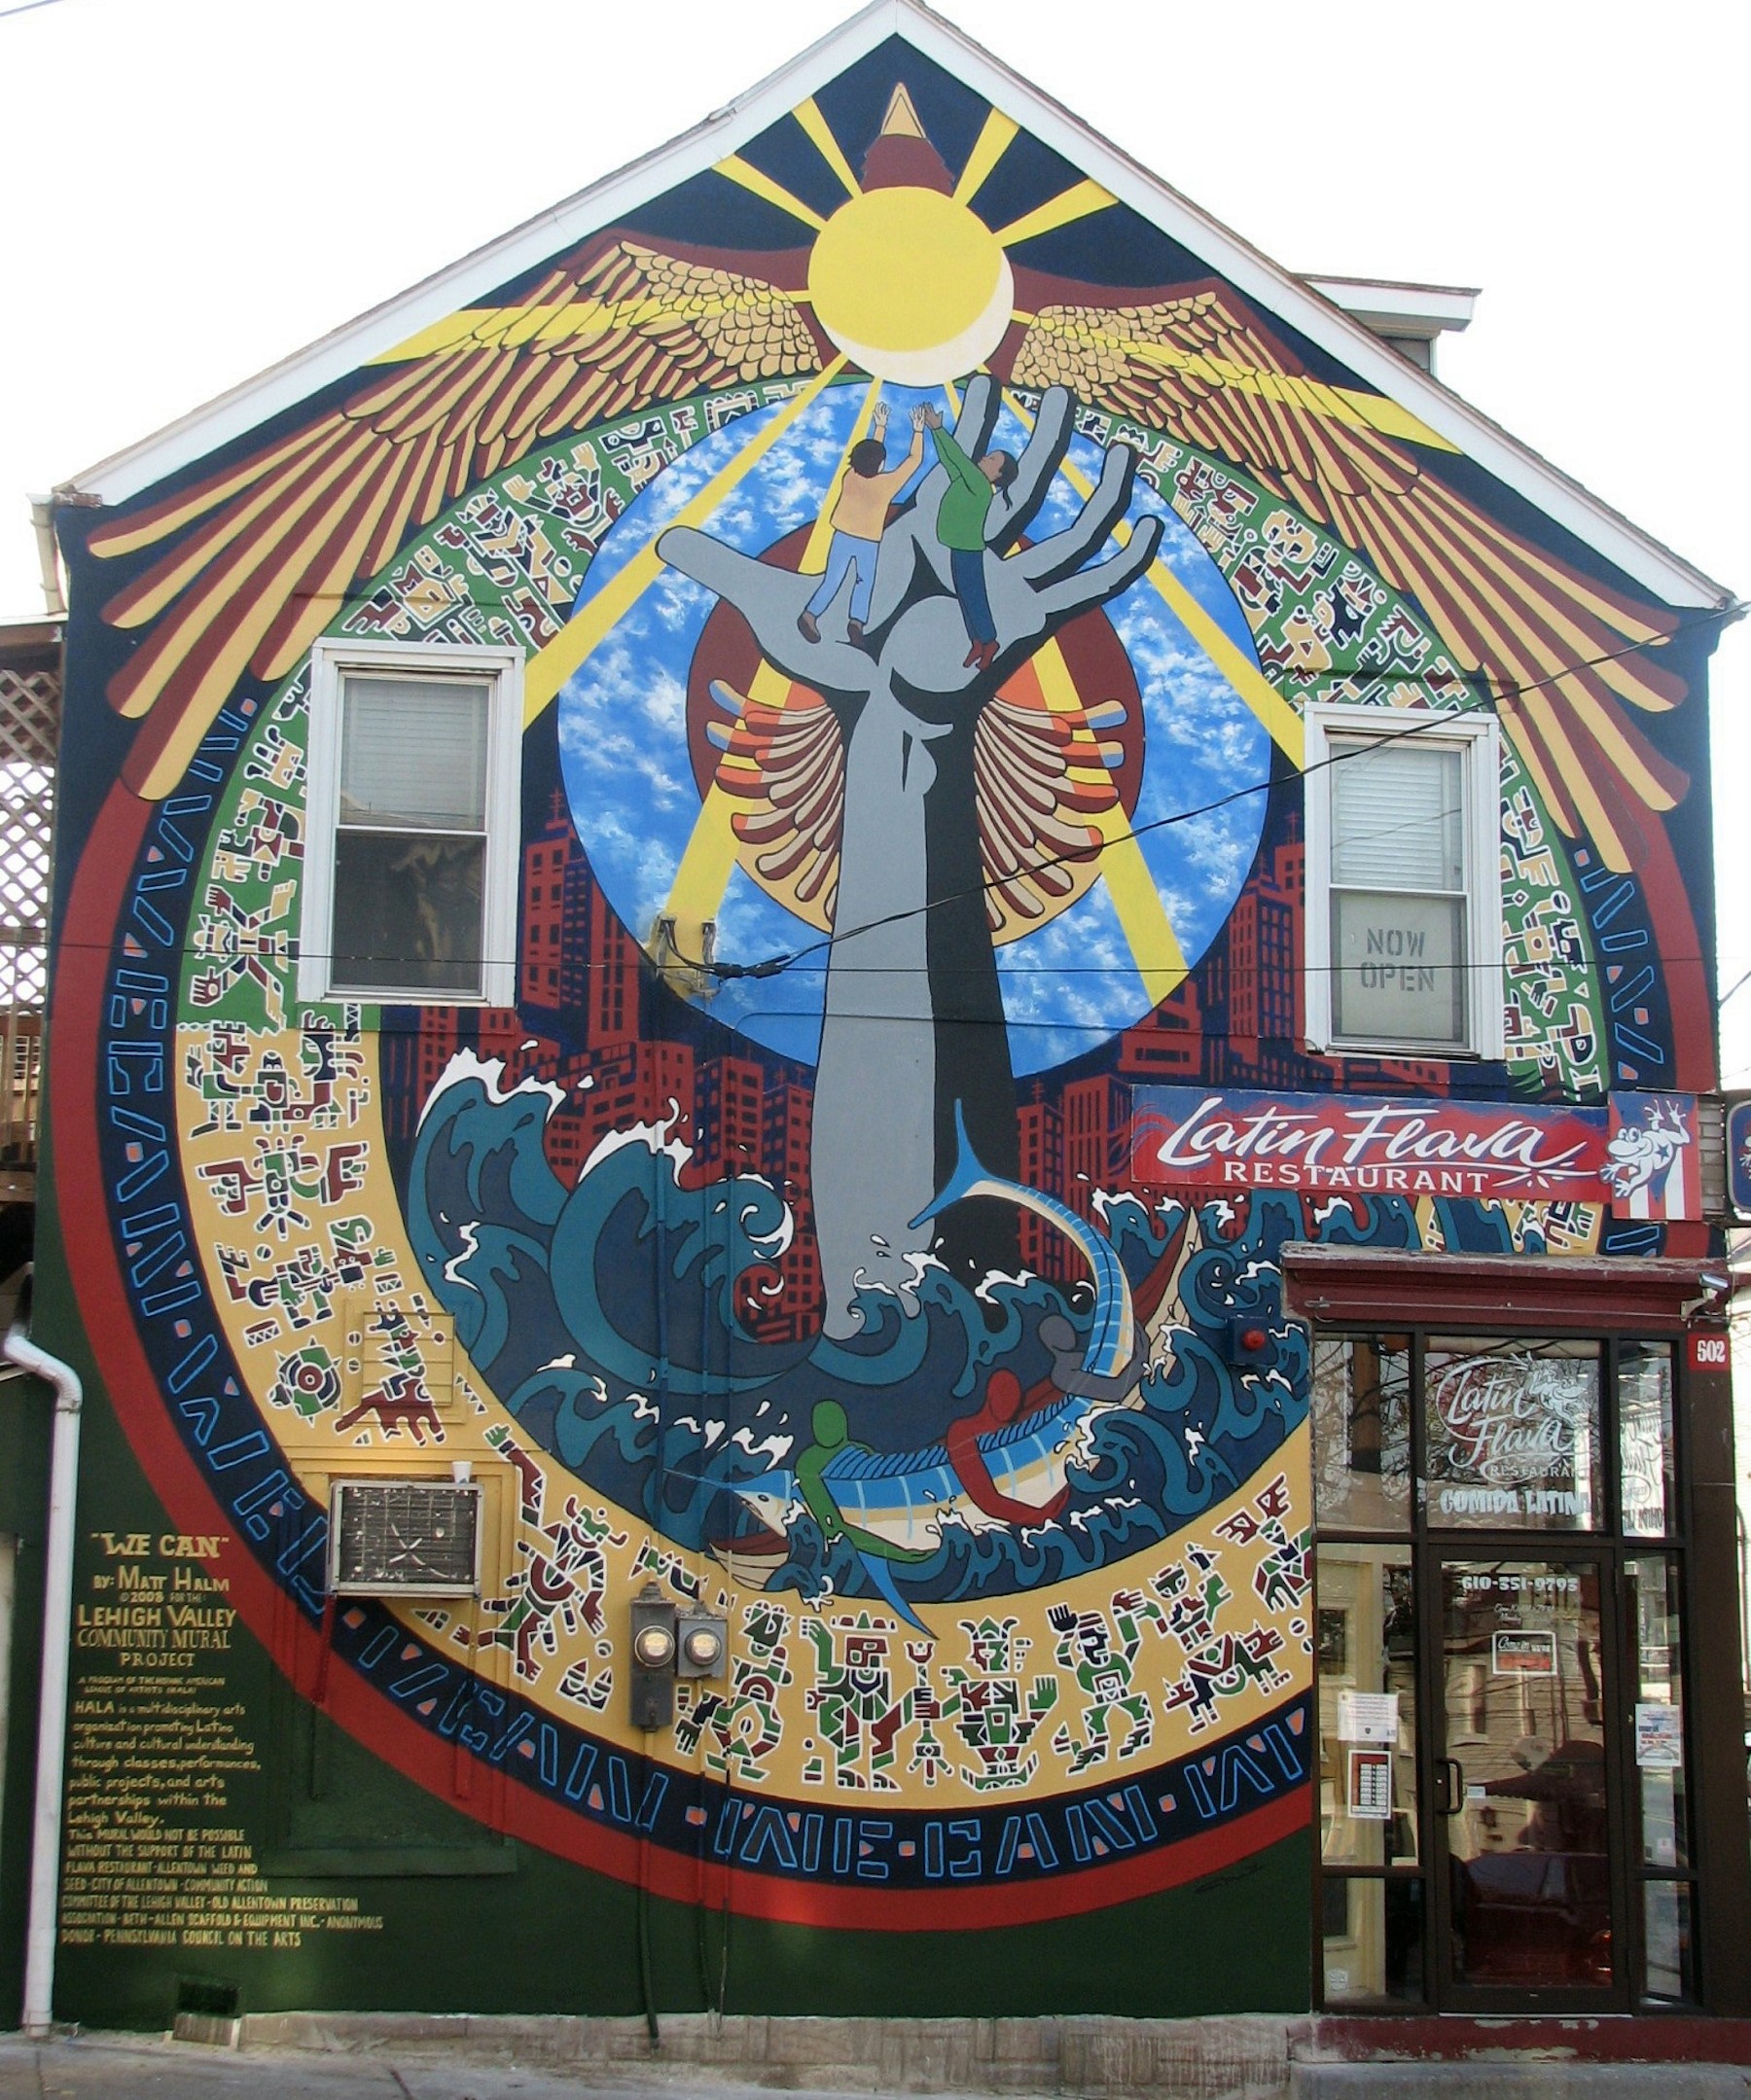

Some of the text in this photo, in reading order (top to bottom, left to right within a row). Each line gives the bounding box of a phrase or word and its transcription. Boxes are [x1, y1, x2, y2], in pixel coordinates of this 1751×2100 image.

[1367, 928, 1425, 957] NOW
[1360, 961, 1435, 992] OPEN
[1157, 1097, 1588, 1166] Latin Flava
[1224, 1161, 1488, 1192] RESTAURANT
[1447, 1370, 1539, 1425] Latin
[1448, 1414, 1575, 1468] Flava
[1440, 1489, 1520, 1514] COMIDA
[78, 1604, 236, 1627] LEHIGH VALLEY
[77, 1628, 232, 1649] COMMUNITY MURAL
[121, 1653, 196, 1666] PROJECT
[75, 1701, 114, 1714] HALA
[223, 1702, 245, 1715] arts
[144, 1720, 195, 1736] promoting
[196, 1720, 233, 1733] Latino
[73, 1736, 255, 1755] culture and cultural understanding
[72, 1755, 119, 1772] through
[69, 1774, 101, 1790] public
[195, 1774, 225, 1789] arts
[68, 1794, 228, 1810] partnerships within the
[67, 1811, 109, 1829] Lehigh
[97, 1829, 129, 1840] MURAL
[131, 1829, 162, 1840] WOULD
[164, 1829, 184, 1841] NOT
[187, 1829, 198, 1841] BE
[201, 1829, 245, 1841] POSSIBLE
[67, 1844, 252, 1859] WITHOUT THE SUPPORT OF THE LATIN
[66, 1861, 95, 1873] FLAVA
[238, 1863, 258, 1875] AND
[236, 1879, 268, 1893] ACTION
[232, 1897, 286, 1909] ALLENTOWN
[290, 1898, 359, 1911] PRESERVATION
[188, 1913, 232, 1927] SCAFFOLD
[243, 1914, 296, 1927] EQUIPMENT
[183, 1930, 224, 1944] COUNCIL
[229, 1931, 242, 1945] ON
[247, 1931, 268, 1945] THE
[273, 1932, 302, 1946] ARTS
